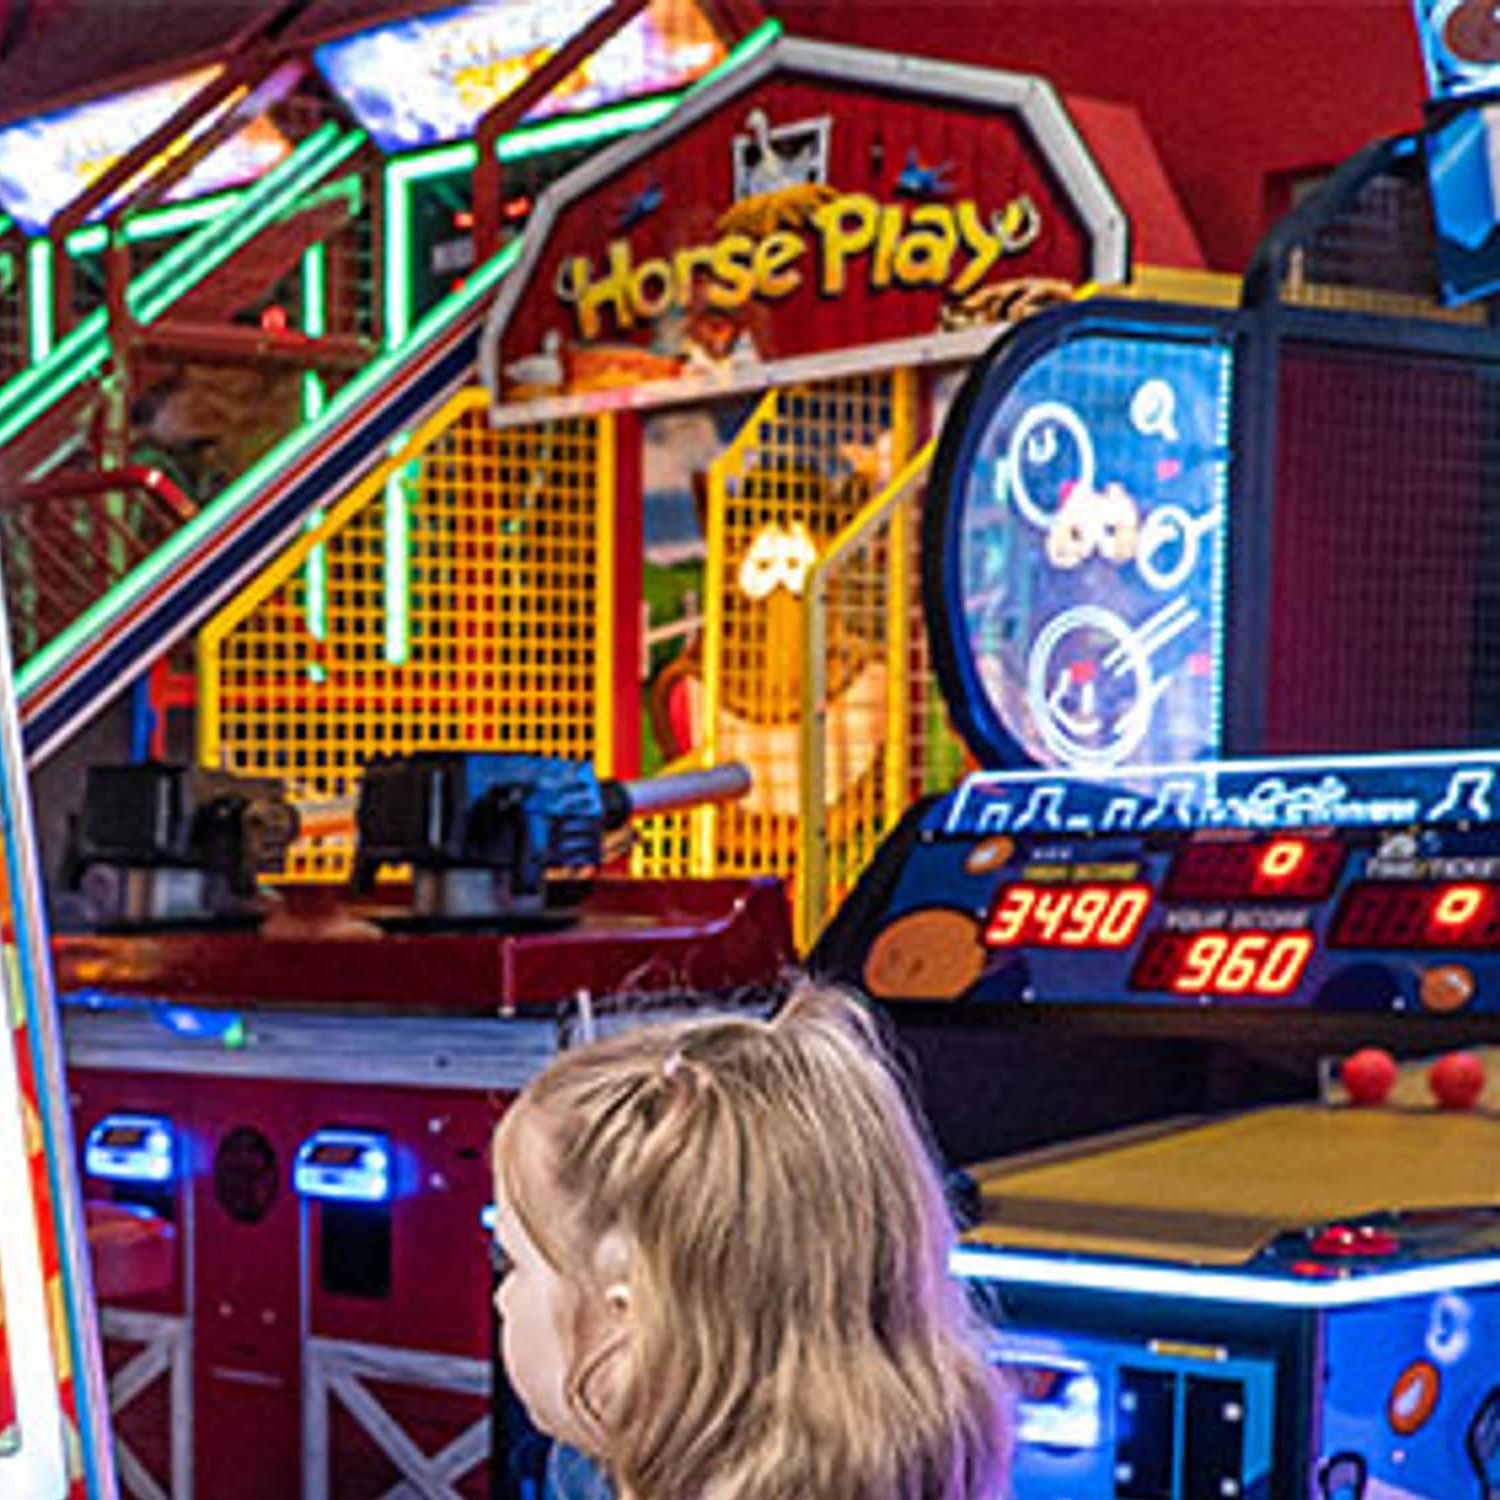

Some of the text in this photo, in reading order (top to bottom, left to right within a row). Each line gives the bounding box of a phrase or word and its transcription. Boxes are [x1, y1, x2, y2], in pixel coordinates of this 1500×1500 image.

[557, 192, 1041, 338] Horse Play
[985, 884, 1153, 946] 3490
[1174, 934, 1314, 993] 960
